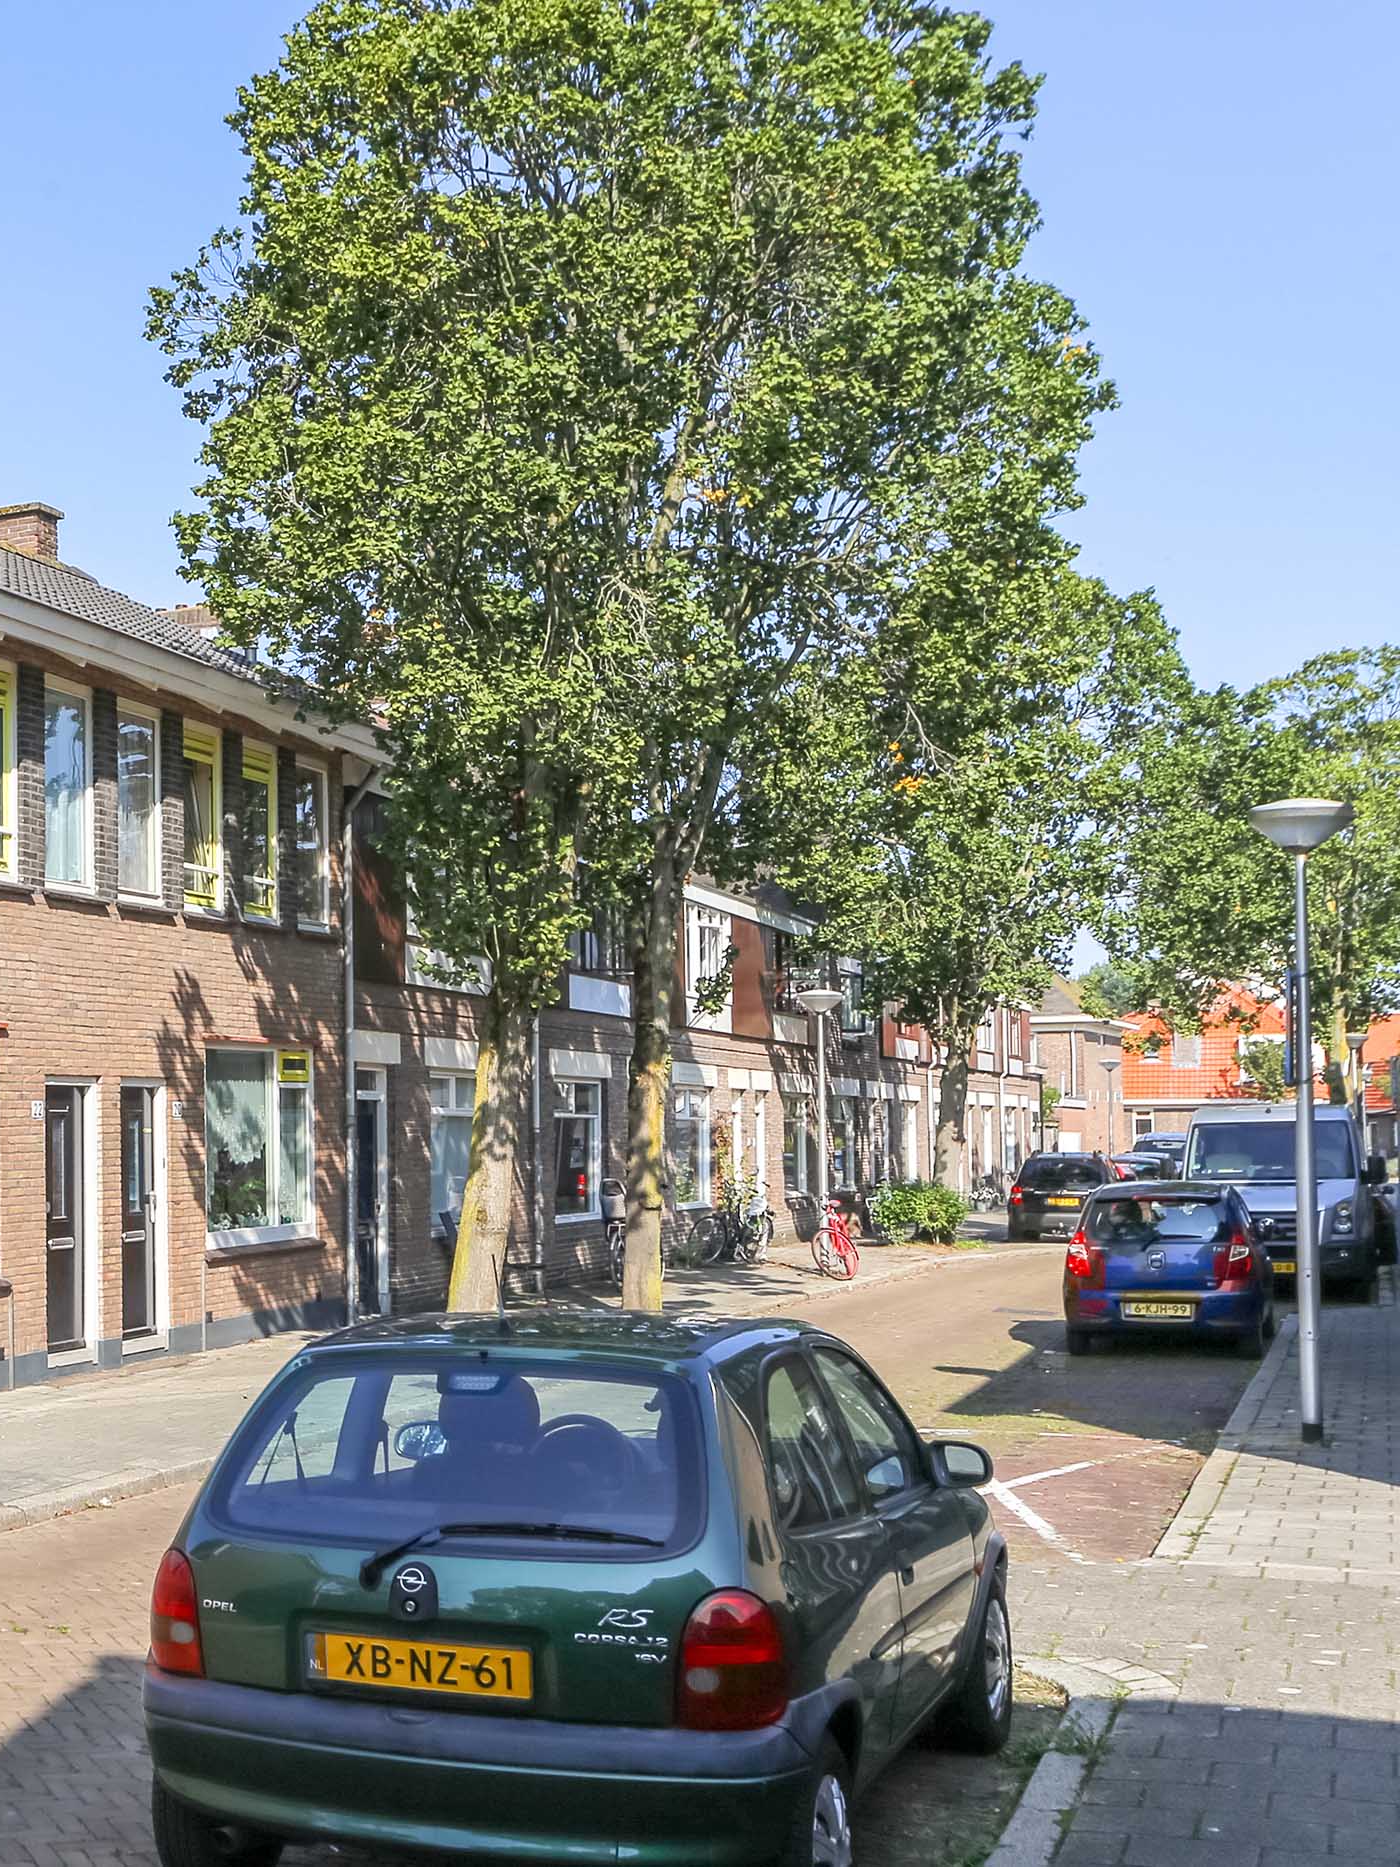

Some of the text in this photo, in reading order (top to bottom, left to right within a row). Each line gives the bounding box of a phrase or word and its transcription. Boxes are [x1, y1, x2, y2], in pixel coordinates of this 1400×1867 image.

[1134, 1303, 1188, 1314] 6-KJH-99
[203, 1599, 237, 1613] OPEL
[574, 1632, 639, 1645] CORSA
[309, 1659, 325, 1672] NL
[345, 1642, 514, 1690] XB-NZ-61
